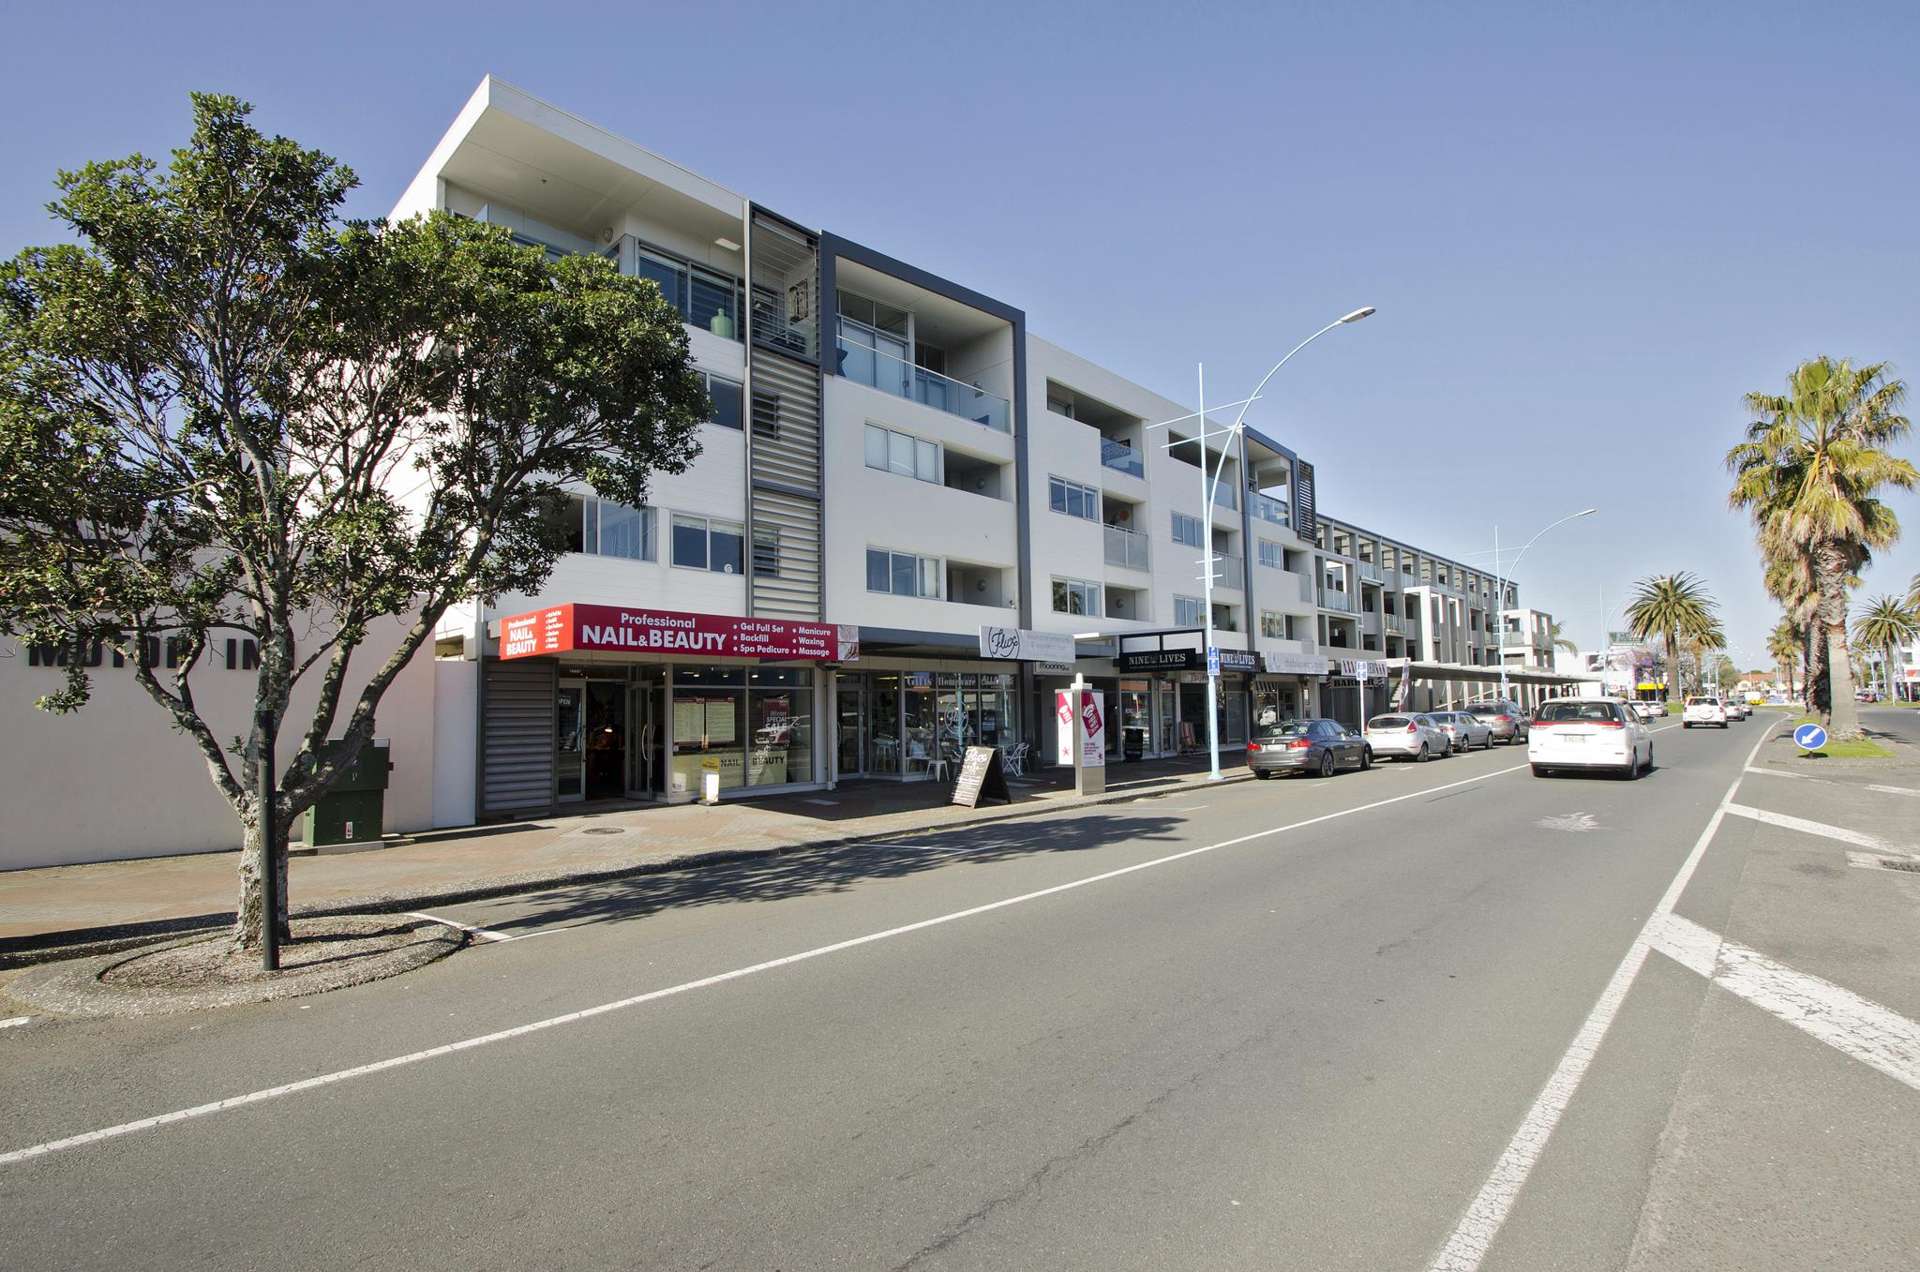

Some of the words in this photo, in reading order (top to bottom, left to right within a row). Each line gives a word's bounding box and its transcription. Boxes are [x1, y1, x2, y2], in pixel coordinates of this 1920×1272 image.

[621, 612, 695, 629] Professional
[741, 622, 755, 631] Gel
[756, 623, 771, 632] Full
[772, 624, 784, 633] Set
[799, 627, 831, 636] Manicure
[740, 633, 769, 642] Backfill
[799, 637, 825, 648] Waxing
[506, 639, 537, 657] BEAUTY
[740, 645, 755, 654] Spa
[757, 645, 789, 654] Pedicure
[799, 648, 830, 657] Massage
[1128, 655, 1150, 665] NINE
[1159, 653, 1186, 664] LIVES
[1239, 654, 1256, 665] LIVES
